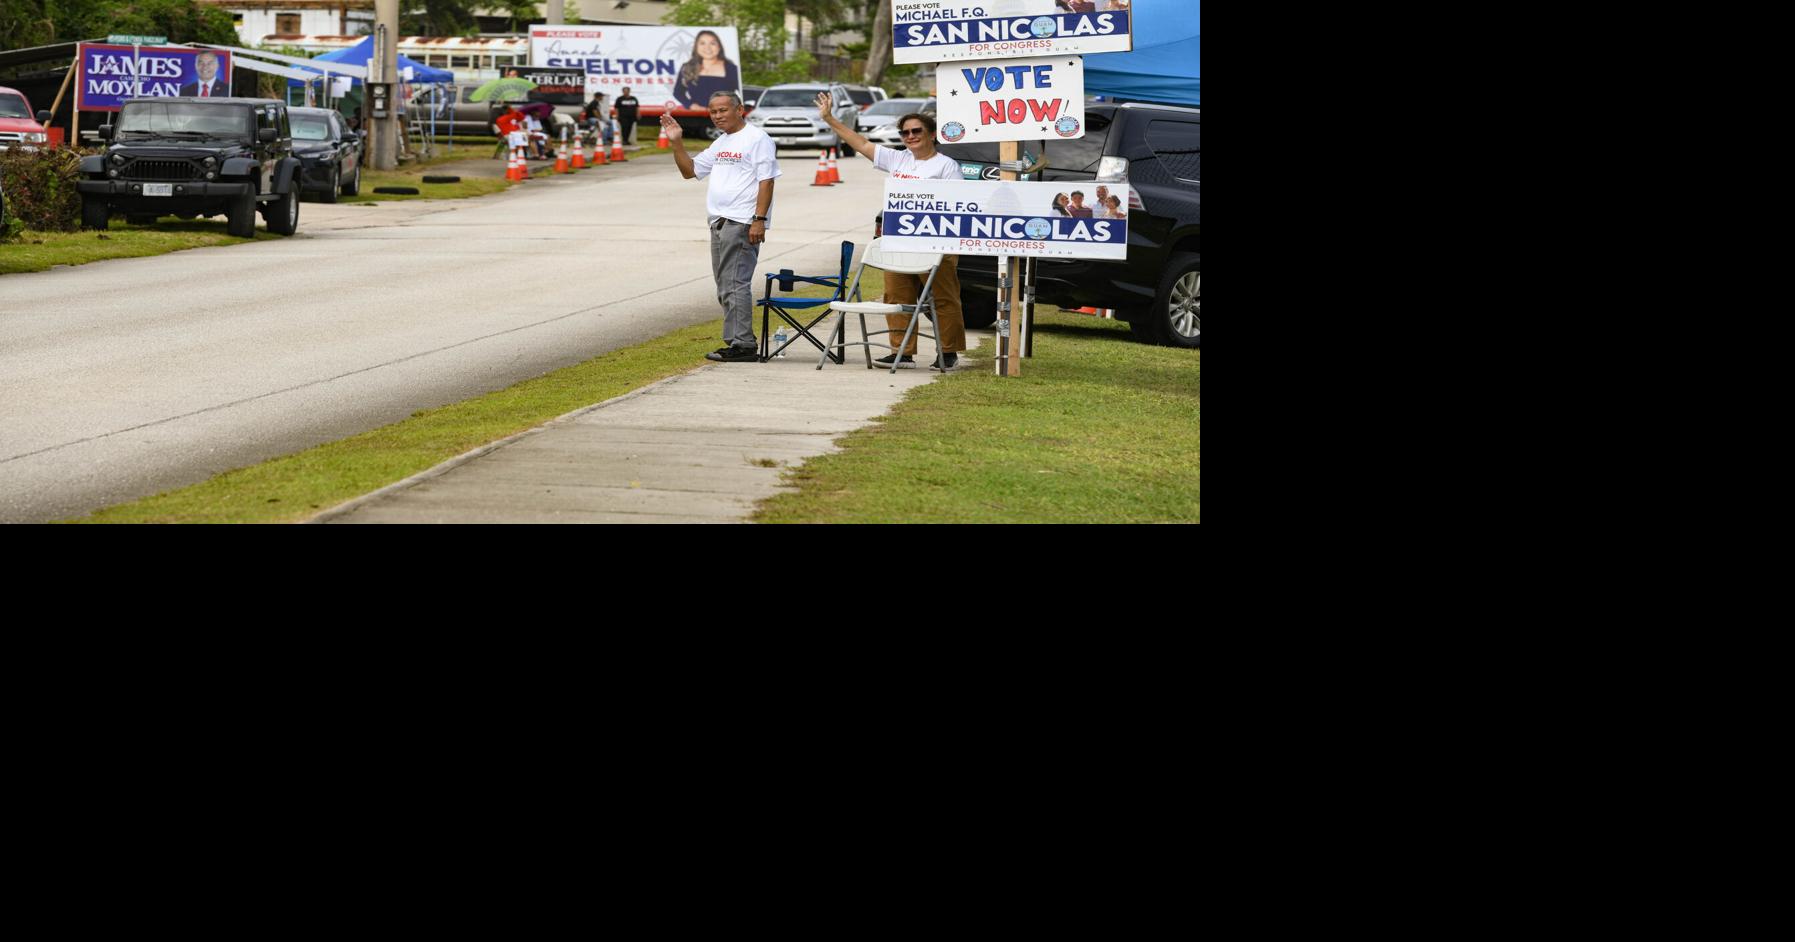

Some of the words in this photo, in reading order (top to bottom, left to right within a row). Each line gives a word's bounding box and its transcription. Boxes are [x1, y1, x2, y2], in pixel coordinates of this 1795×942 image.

[896, 9, 957, 22] MICHAEL
[962, 7, 988, 18] F.Q.
[907, 22, 969, 46] SAN
[978, 13, 1115, 41] NICOLAS
[969, 43, 990, 52] FOR
[993, 40, 1053, 50] CONGRESS
[87, 54, 183, 78] JAMES
[525, 75, 584, 87] TERLAJE
[590, 77, 675, 85] CONGRESS
[961, 64, 1053, 93] VOTE
[87, 79, 181, 97] MOYLAN
[888, 200, 951, 212] MICHAEL
[955, 202, 983, 213] F.Q.
[897, 214, 961, 237] SAN
[971, 216, 1112, 242] NICOLAS
[960, 239, 981, 247] FOR
[985, 240, 1046, 250] CONGRESS
